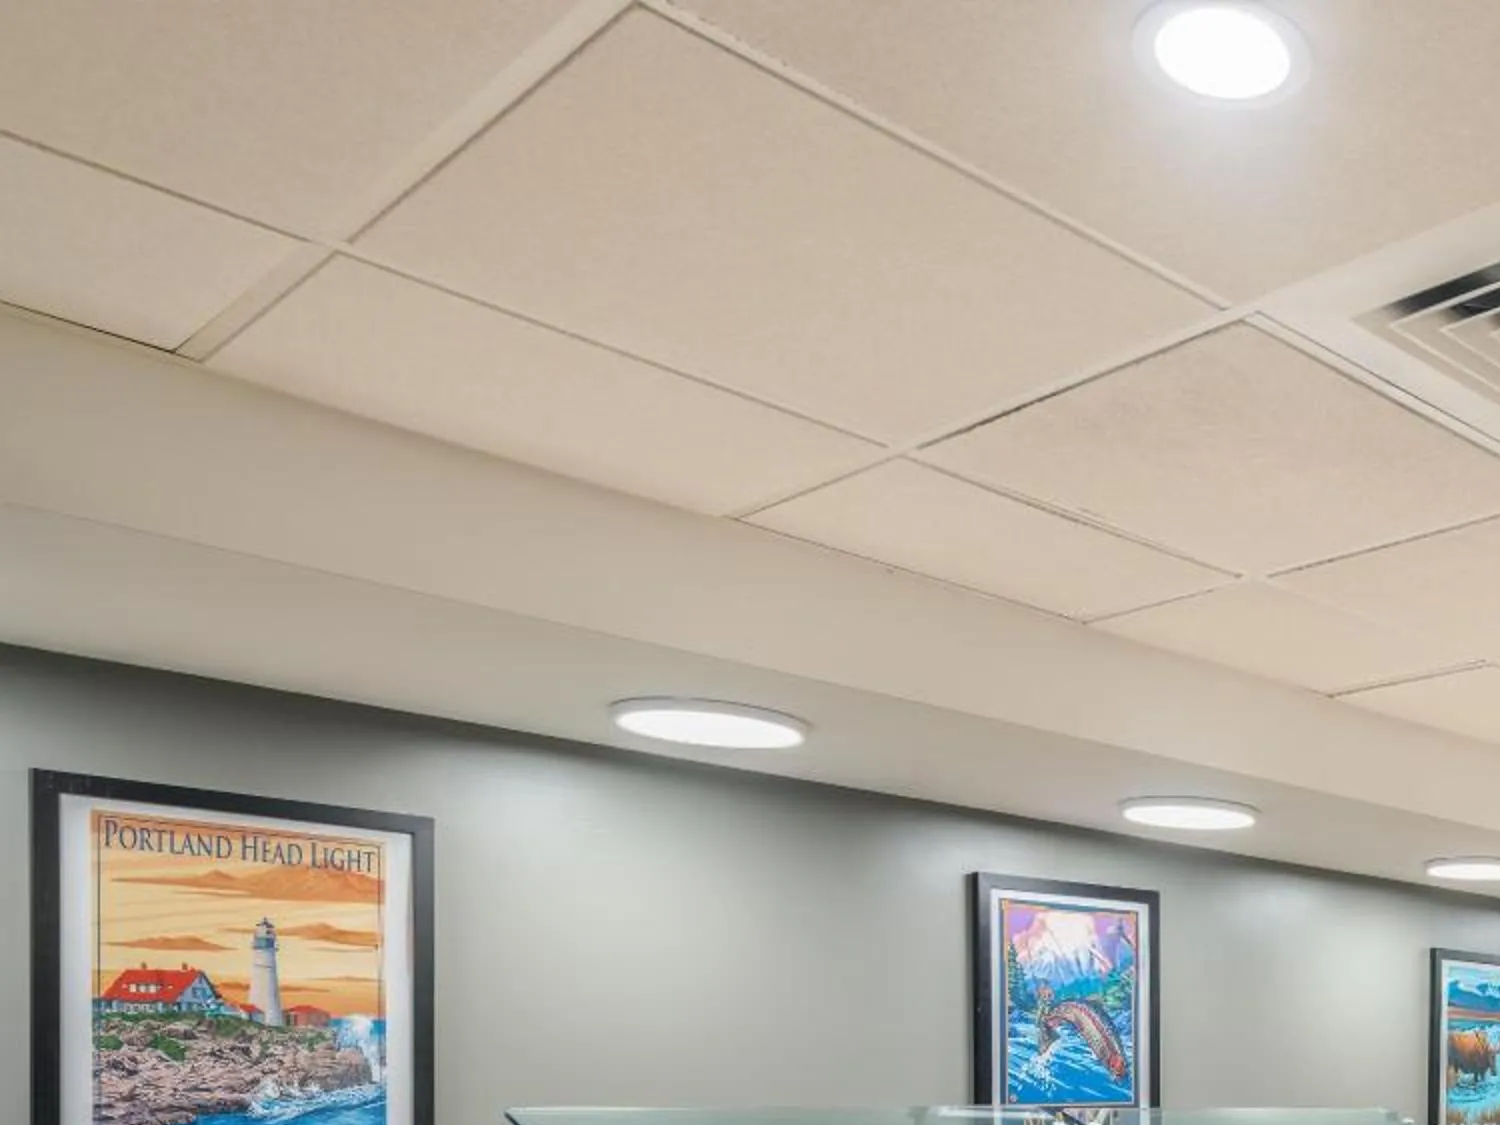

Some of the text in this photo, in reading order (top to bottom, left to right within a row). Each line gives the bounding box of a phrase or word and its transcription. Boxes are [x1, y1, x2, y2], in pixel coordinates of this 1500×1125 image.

[104, 819, 376, 873] PORTLAND HEAD LIGHT
